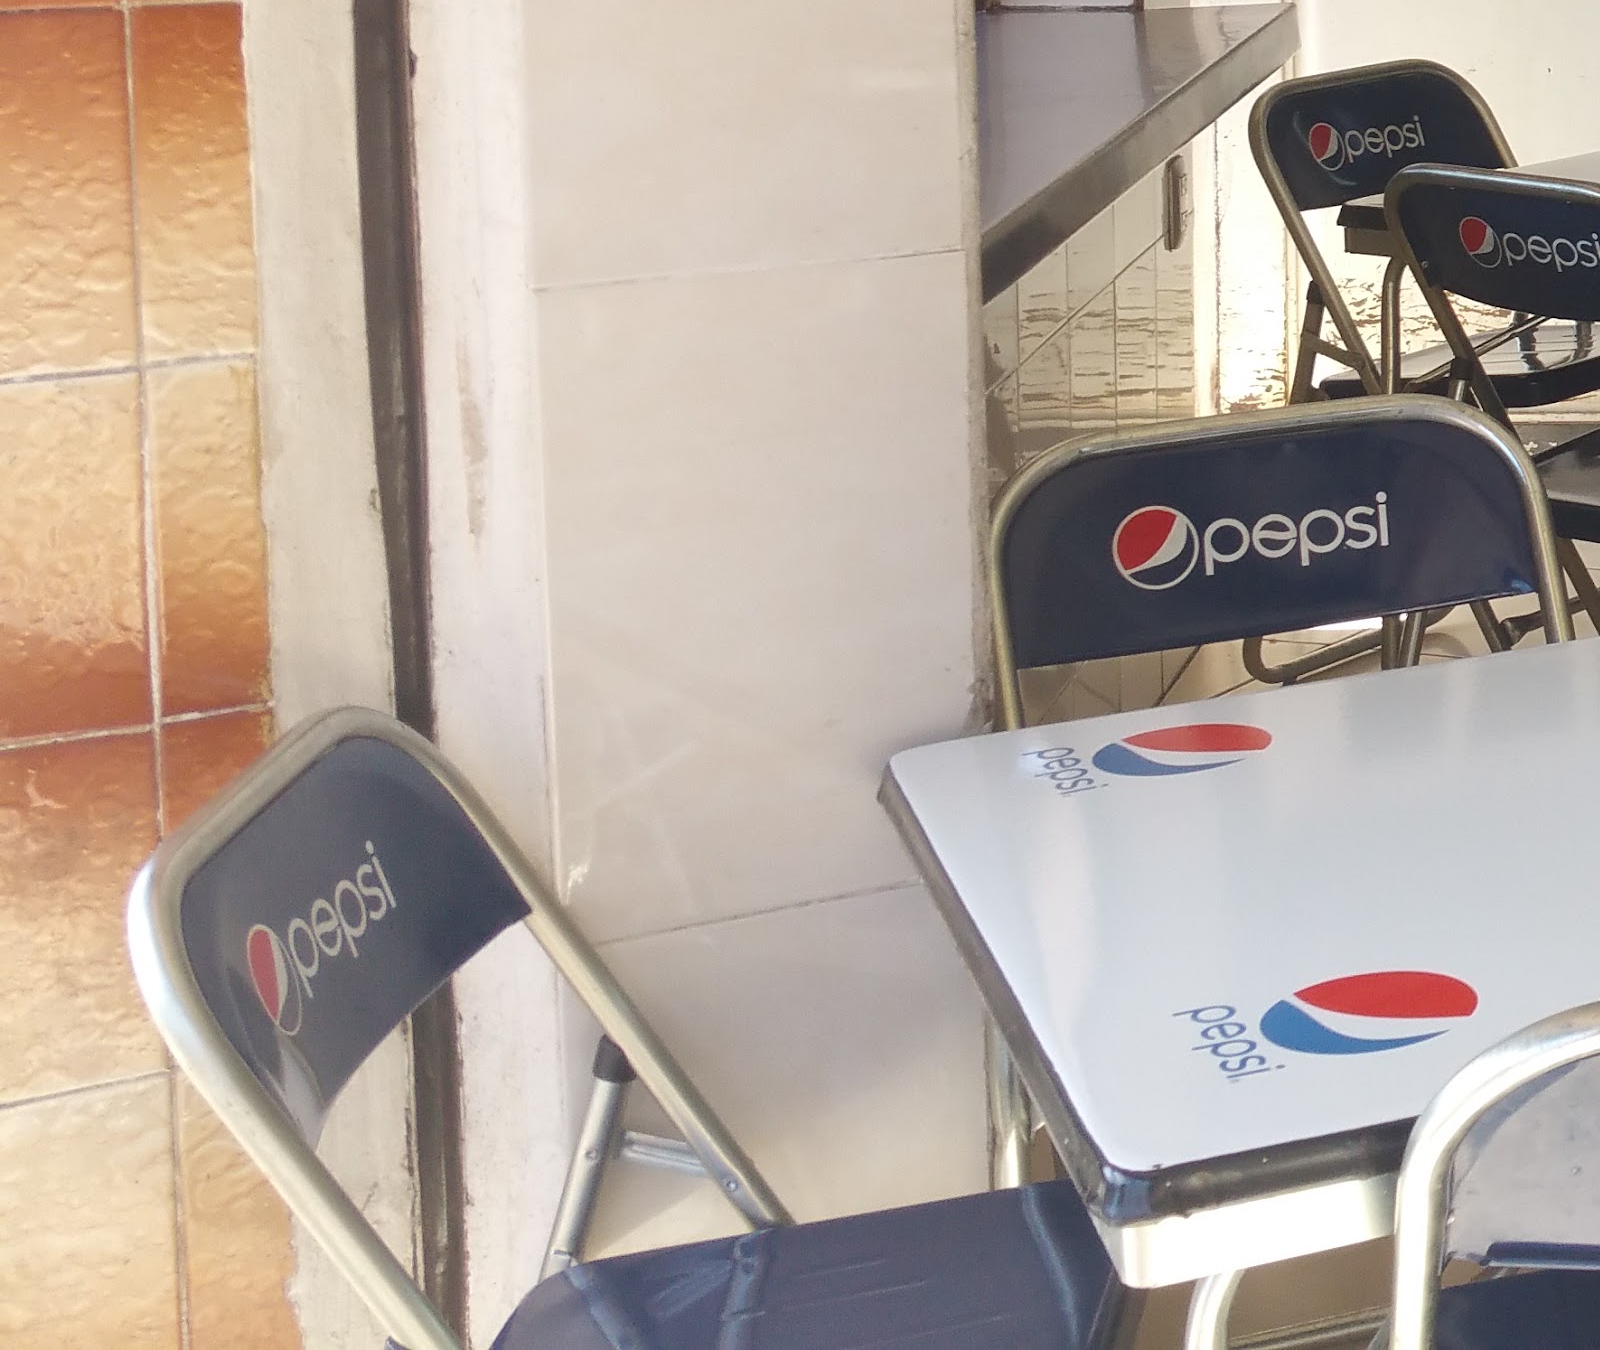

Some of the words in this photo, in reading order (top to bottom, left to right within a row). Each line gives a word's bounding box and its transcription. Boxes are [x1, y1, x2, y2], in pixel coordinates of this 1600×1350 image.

[1347, 116, 1425, 165] pepsi
[1205, 491, 1390, 576] pepsi
[1025, 744, 1097, 797] pepsi
[288, 840, 396, 999] pepsi
[1172, 1005, 1285, 1079] pepsi
